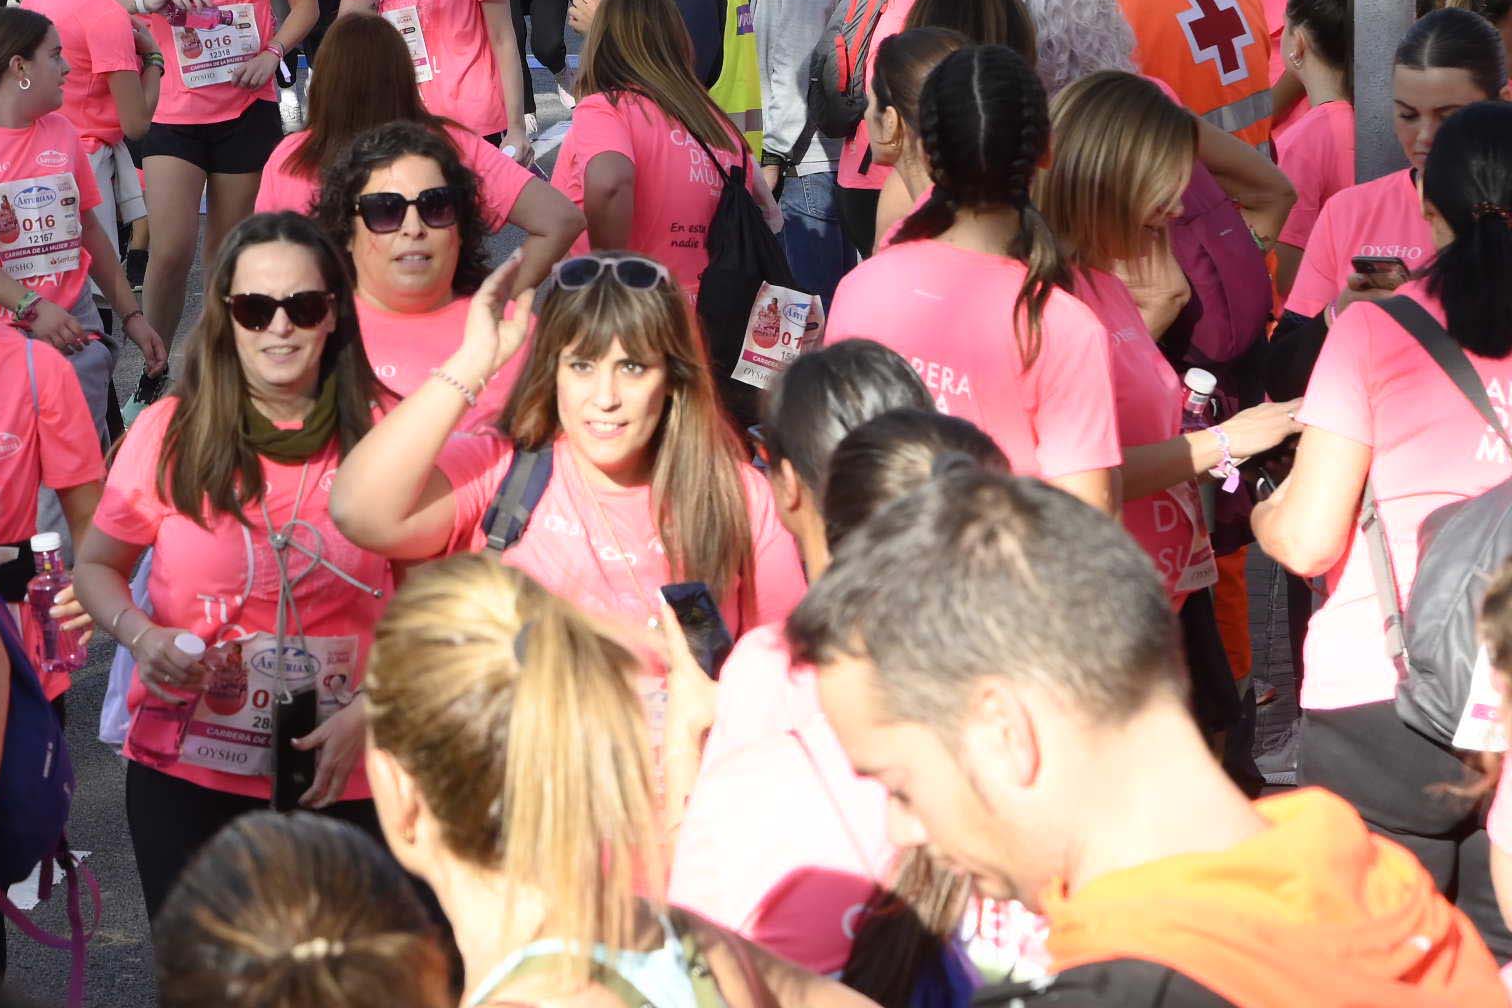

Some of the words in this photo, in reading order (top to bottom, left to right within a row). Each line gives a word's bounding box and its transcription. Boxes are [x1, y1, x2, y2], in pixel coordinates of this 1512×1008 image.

[204, 35, 231, 50] 016
[210, 49, 231, 58] 12318
[689, 168, 723, 187] MUJ
[17, 194, 53, 206] ASTURIANA
[23, 214, 55, 232] 016
[671, 223, 685, 233] En
[28, 233, 53, 244] 12167
[671, 239, 698, 249] nadie
[5, 249, 30, 259] CARRERA
[49, 242, 68, 252] MUJER
[1359, 244, 1422, 260] OYSHO
[782, 332, 802, 349] 01
[753, 356, 777, 367] CARRE
[744, 368, 768, 381] OYSH
[911, 357, 972, 398] RERA
[258, 656, 315, 673] ASRIANA
[252, 716, 273, 729] 28
[206, 727, 252, 742] CARRERA
[254, 736, 267, 744] DE
[197, 745, 248, 764] OYSHO
